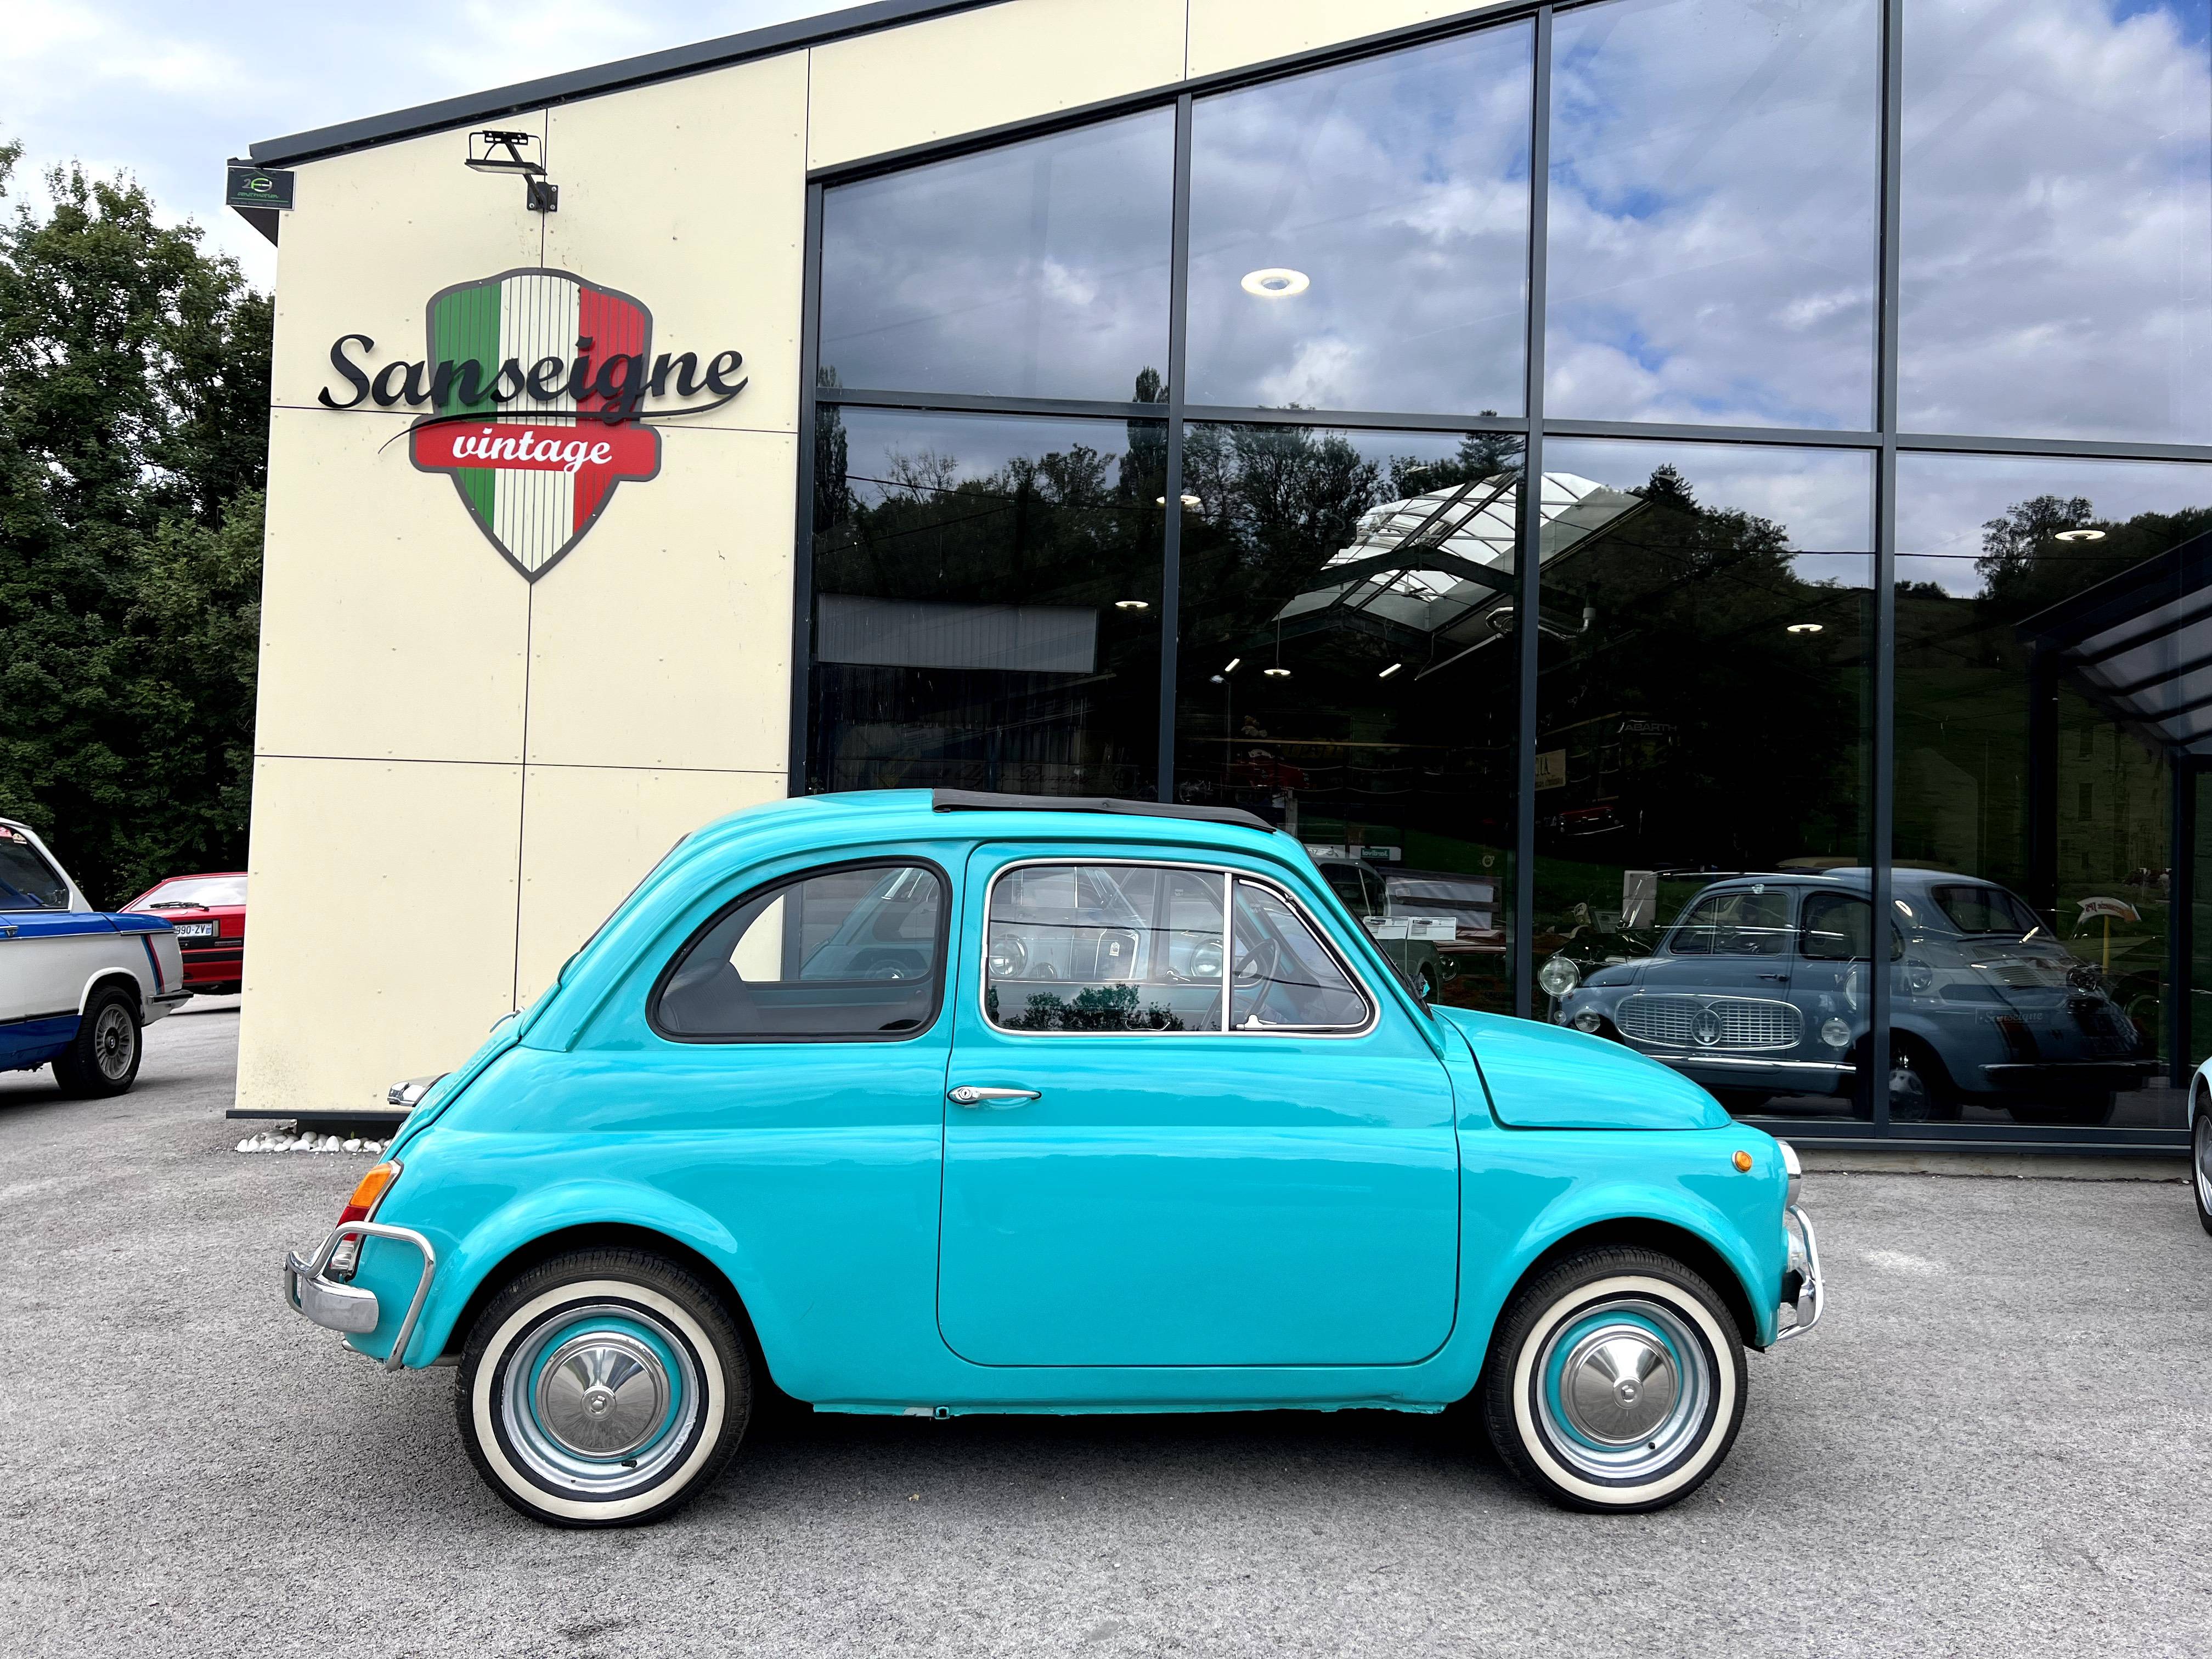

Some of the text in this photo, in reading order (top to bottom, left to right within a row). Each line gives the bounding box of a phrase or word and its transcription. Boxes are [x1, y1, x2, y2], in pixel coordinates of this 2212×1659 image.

[318, 334, 748, 426] Sanseigne
[452, 427, 613, 474] vintage
[1624, 723, 1677, 731] ABARTH
[176, 924, 206, 935] 990-ZV
